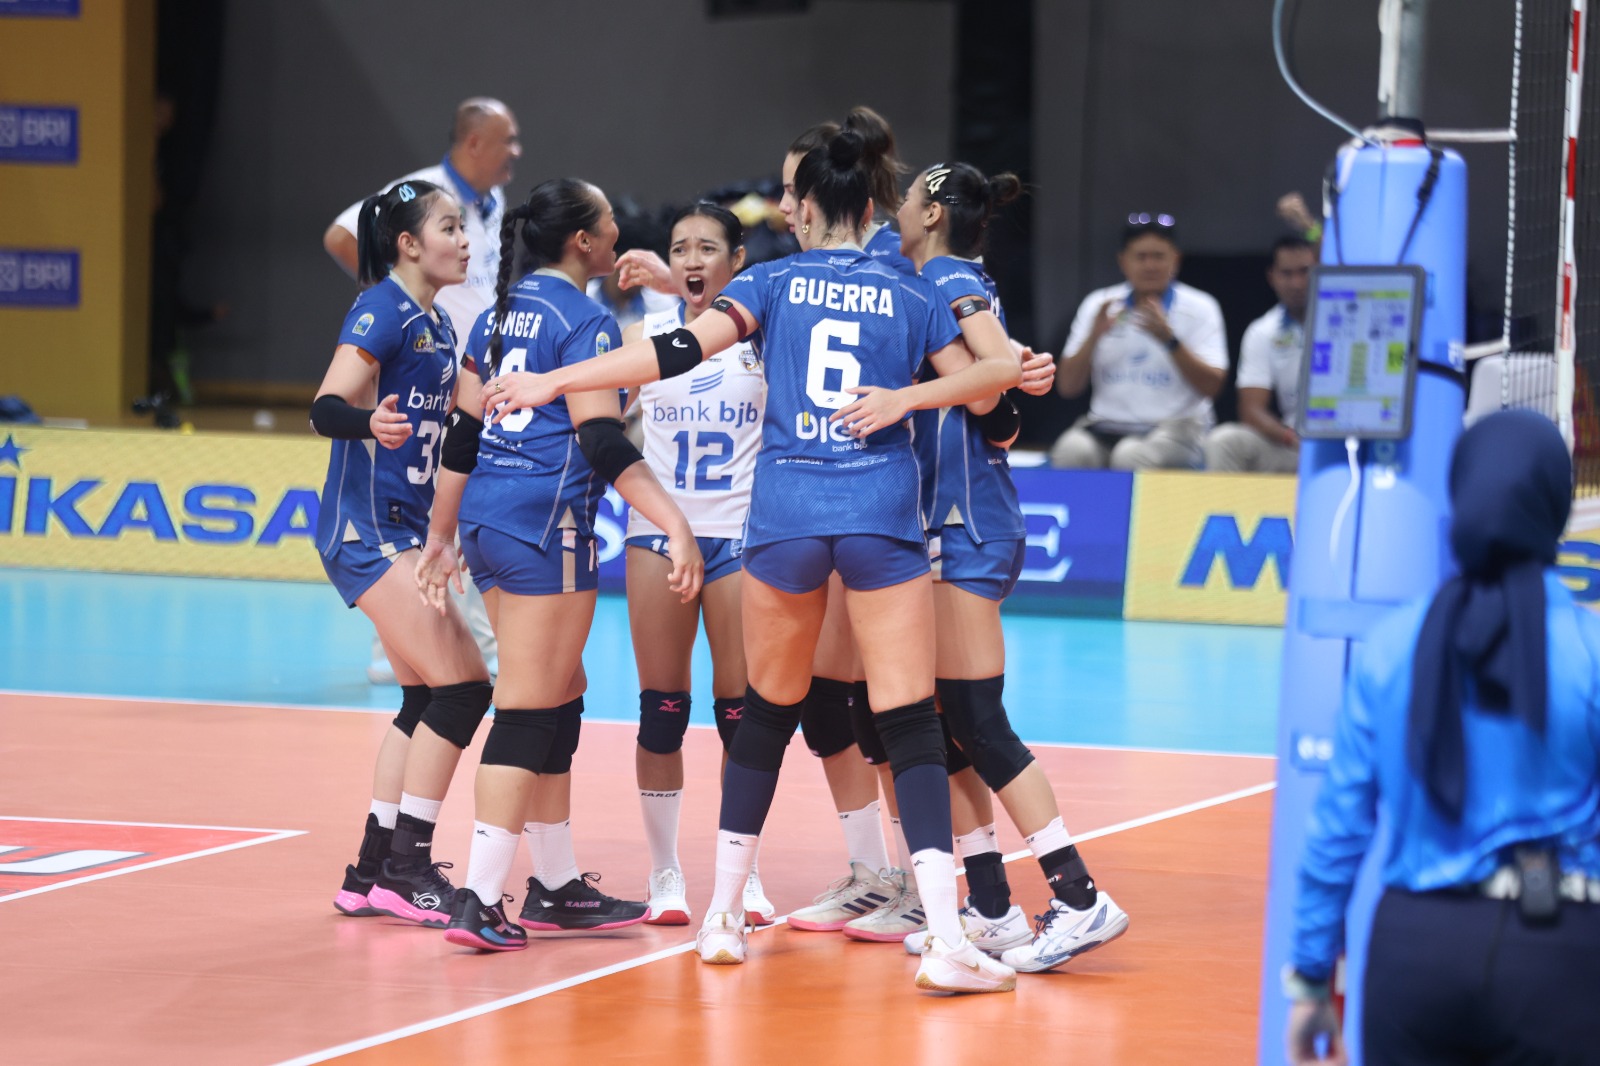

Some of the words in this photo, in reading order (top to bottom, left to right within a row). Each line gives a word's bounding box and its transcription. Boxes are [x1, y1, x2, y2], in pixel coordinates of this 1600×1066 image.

[789, 276, 894, 318] GUERRA
[805, 317, 861, 410] 6
[653, 399, 711, 423] bank
[719, 400, 758, 429] bjb
[672, 430, 735, 491] 12
[832, 443, 852, 453] bank
